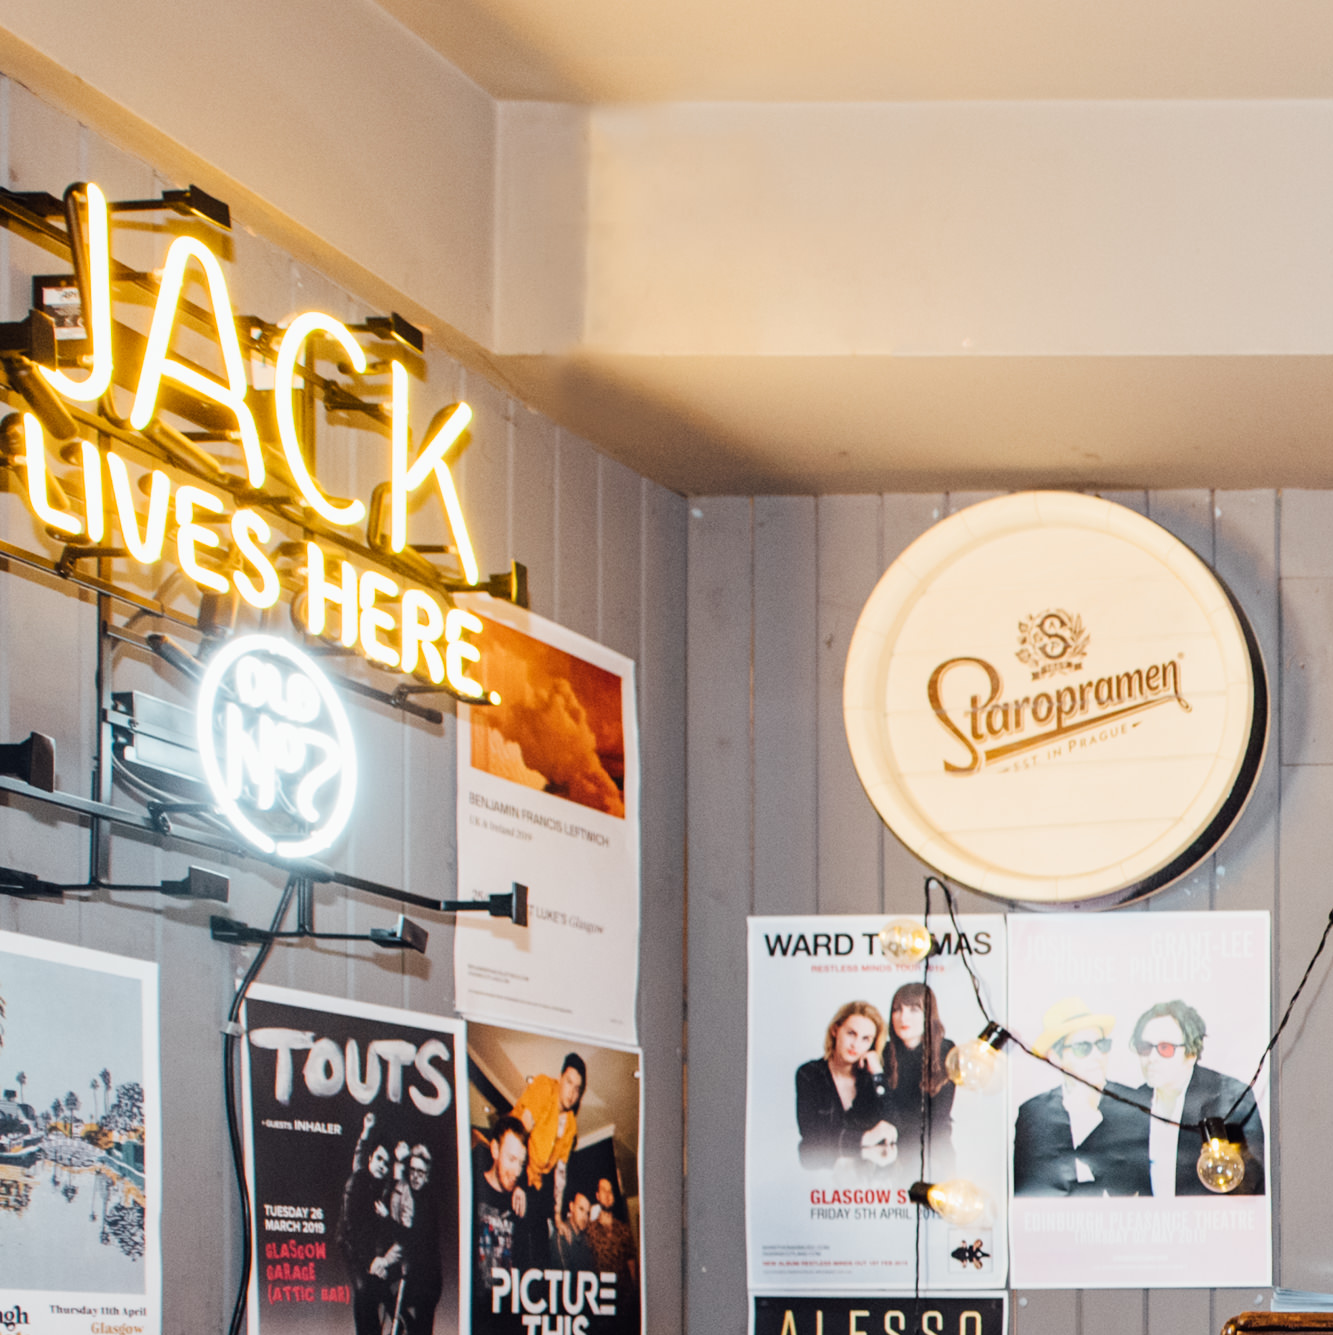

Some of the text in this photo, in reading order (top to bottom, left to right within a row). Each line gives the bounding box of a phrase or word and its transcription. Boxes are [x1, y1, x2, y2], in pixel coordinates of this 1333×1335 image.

[38, 182, 479, 586] JACK
[22, 412, 280, 608] LIVES
[927, 657, 1192, 776] Staropramen
[1013, 724, 1128, 772] EST IN PRAGUE
[469, 792, 609, 848] BENJAMIN FRANCIS LEFTWICH
[764, 932, 992, 956] WARD TMAS
[1151, 931, 1253, 961] GRANT-LEE
[249, 1027, 452, 1117] TOUTS
[264, 1204, 324, 1220] TUESDAY 26
[811, 1190, 891, 1205] GLASGOW
[264, 1219, 325, 1234] MARCH 2019
[265, 1239, 326, 1259] GLASGOW
[266, 1262, 316, 1281] GARAGE
[491, 1267, 617, 1315] PICTURE
[91, 1322, 143, 1335] Glasgow
